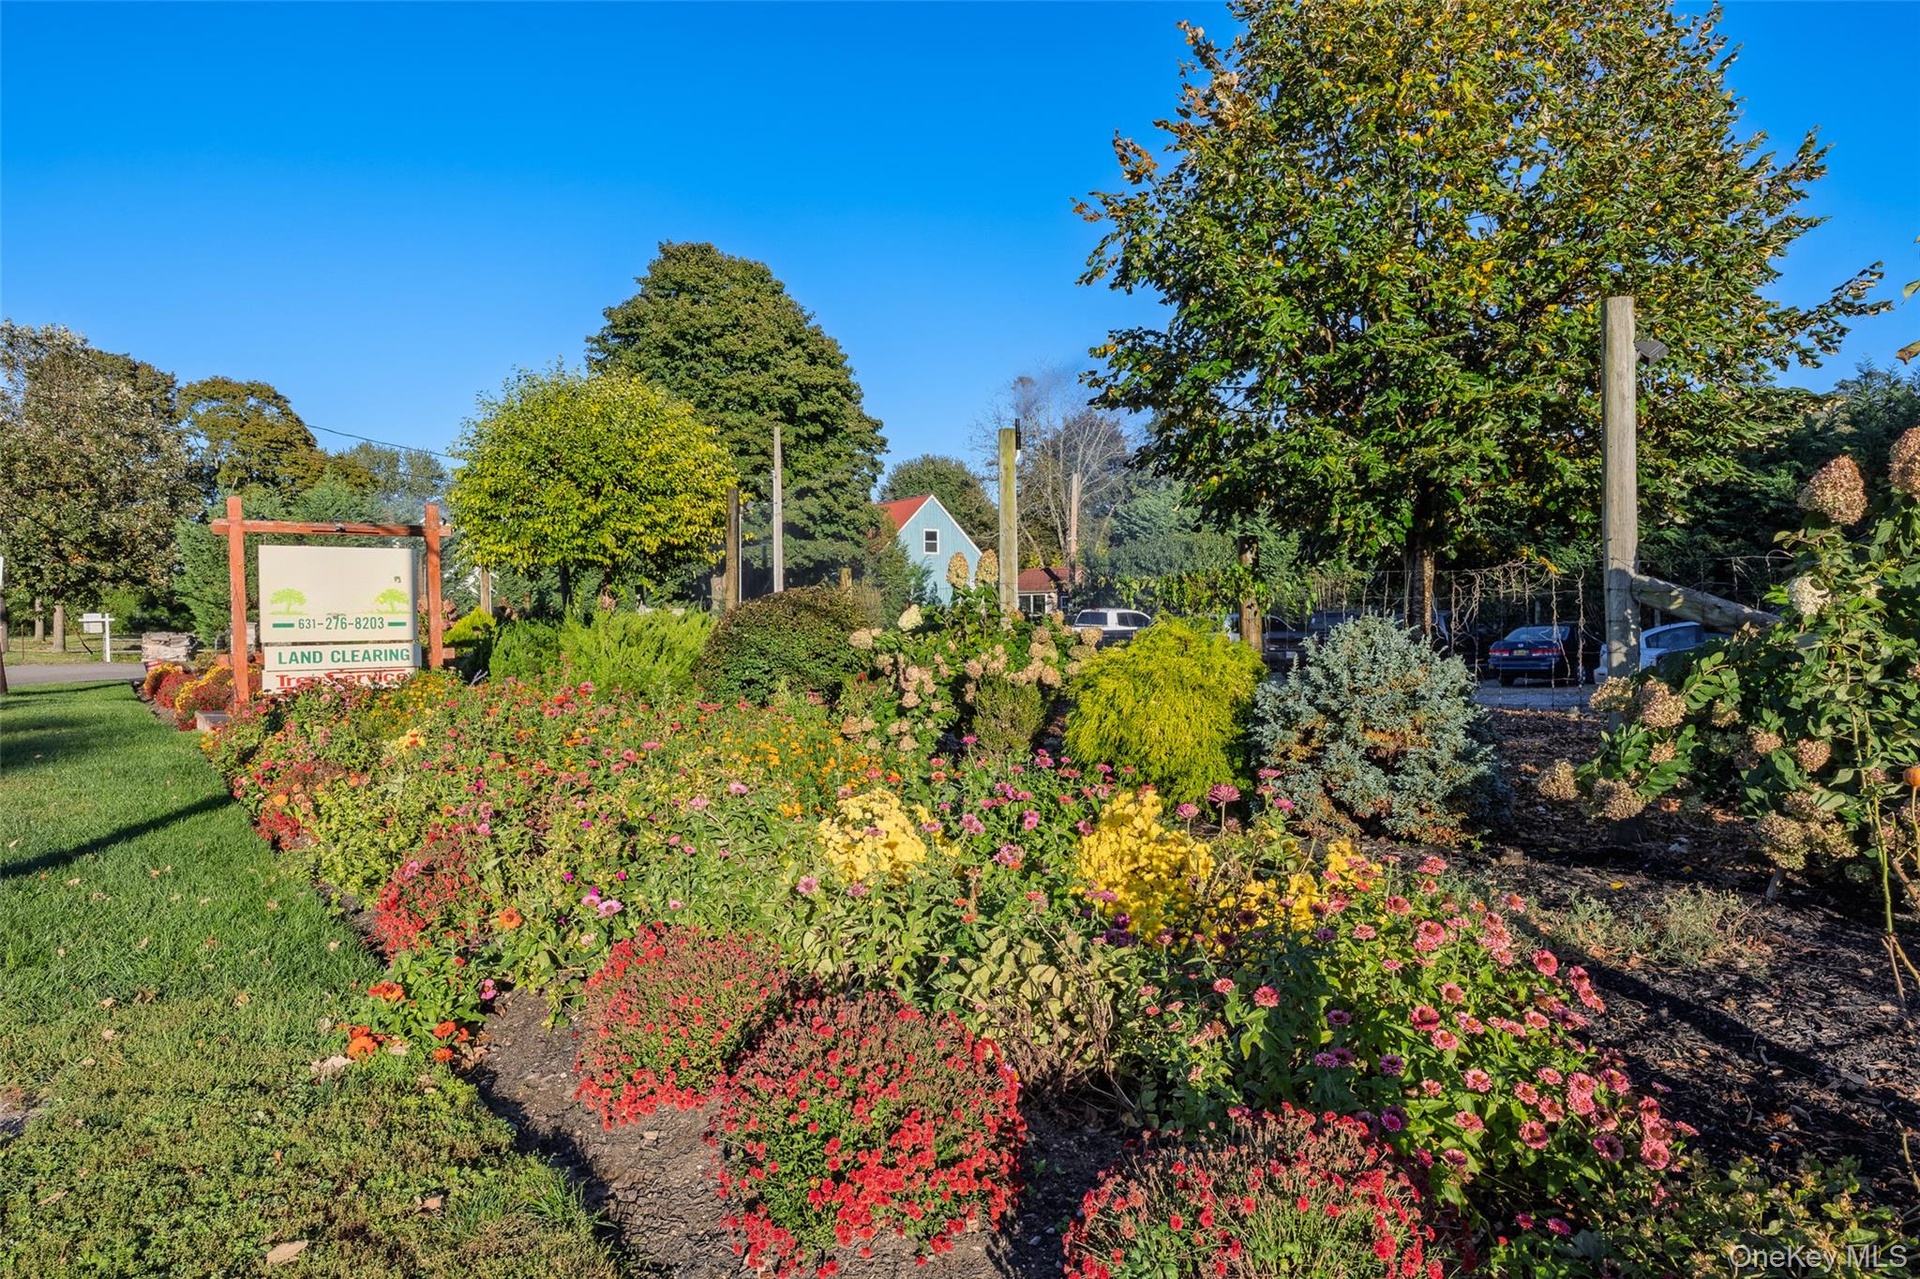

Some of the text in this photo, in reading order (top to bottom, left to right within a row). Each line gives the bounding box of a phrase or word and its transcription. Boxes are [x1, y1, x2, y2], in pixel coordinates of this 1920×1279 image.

[298, 616, 385, 630] 631-276-8203
[278, 648, 411, 664] LAND CLEARING
